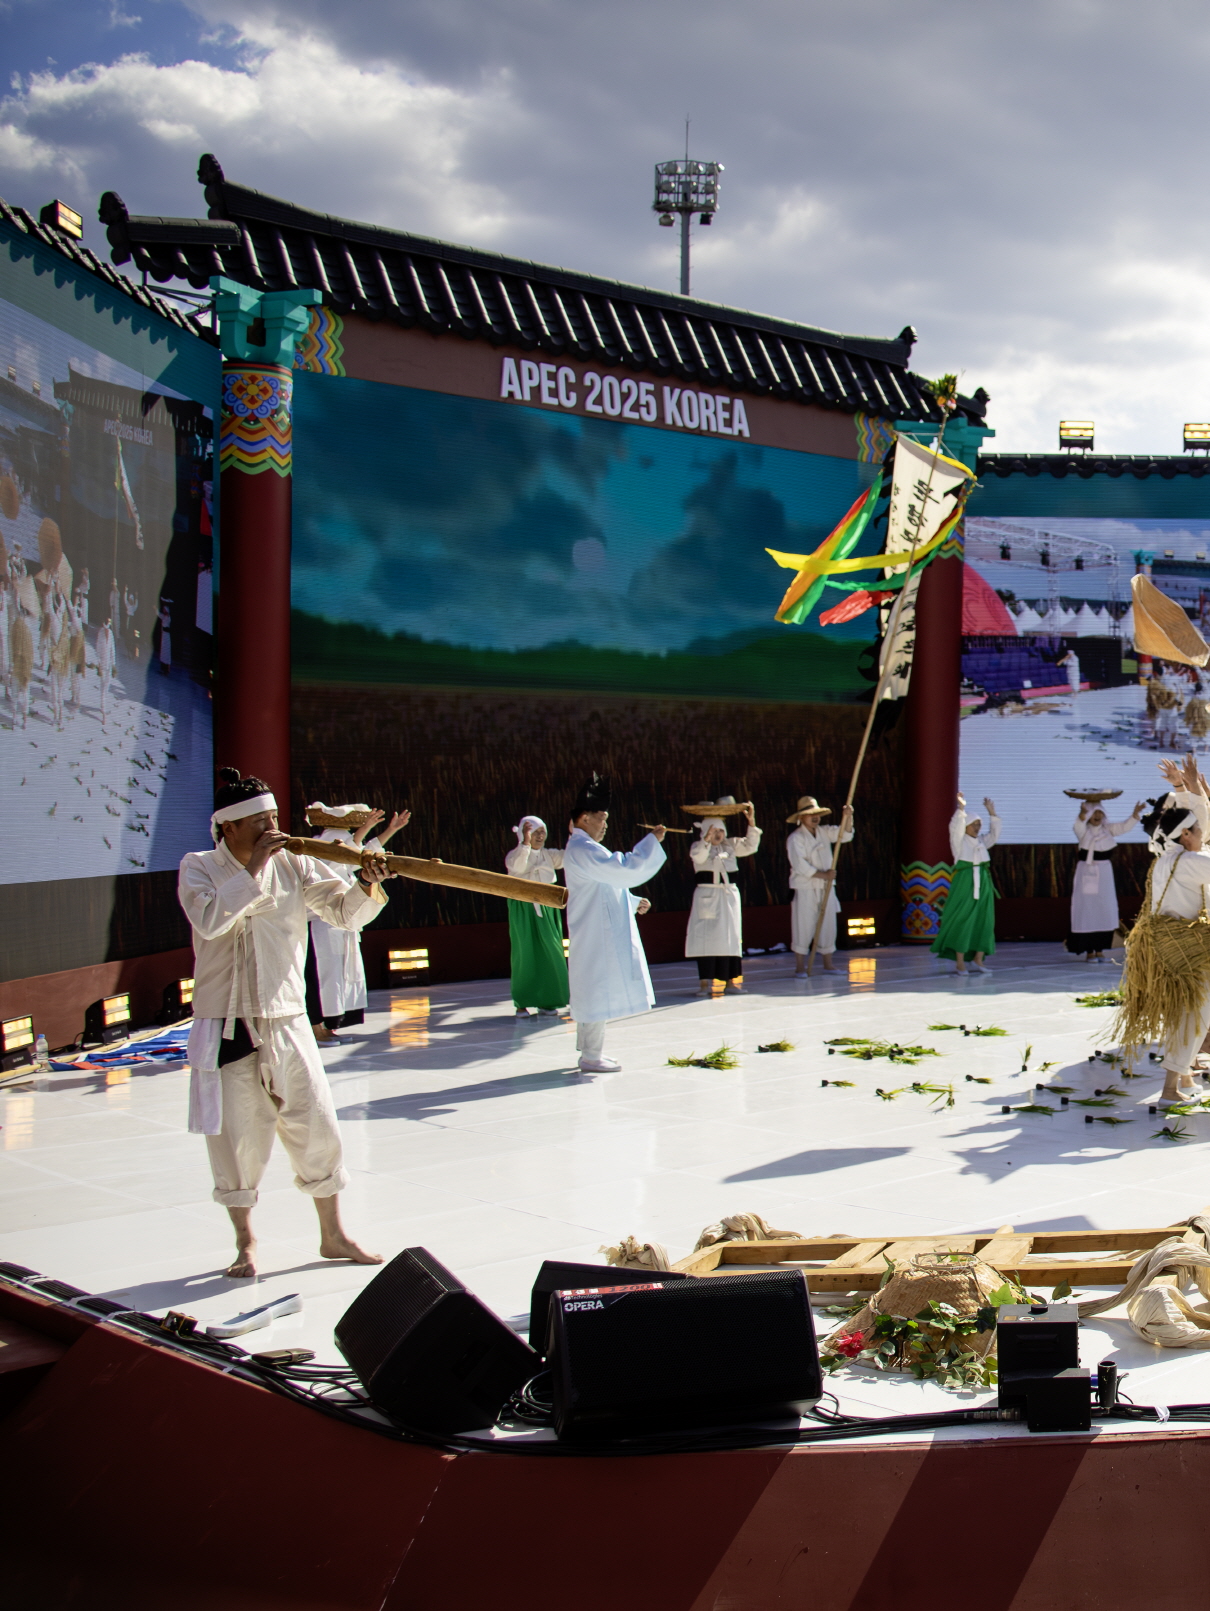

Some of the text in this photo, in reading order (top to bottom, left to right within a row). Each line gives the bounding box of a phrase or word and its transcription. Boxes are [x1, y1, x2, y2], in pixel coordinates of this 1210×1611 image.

[501, 357, 750, 438] APEC 2025 KOREA
[609, 1284, 651, 1293] 1200
[564, 1300, 604, 1312] OPERA
